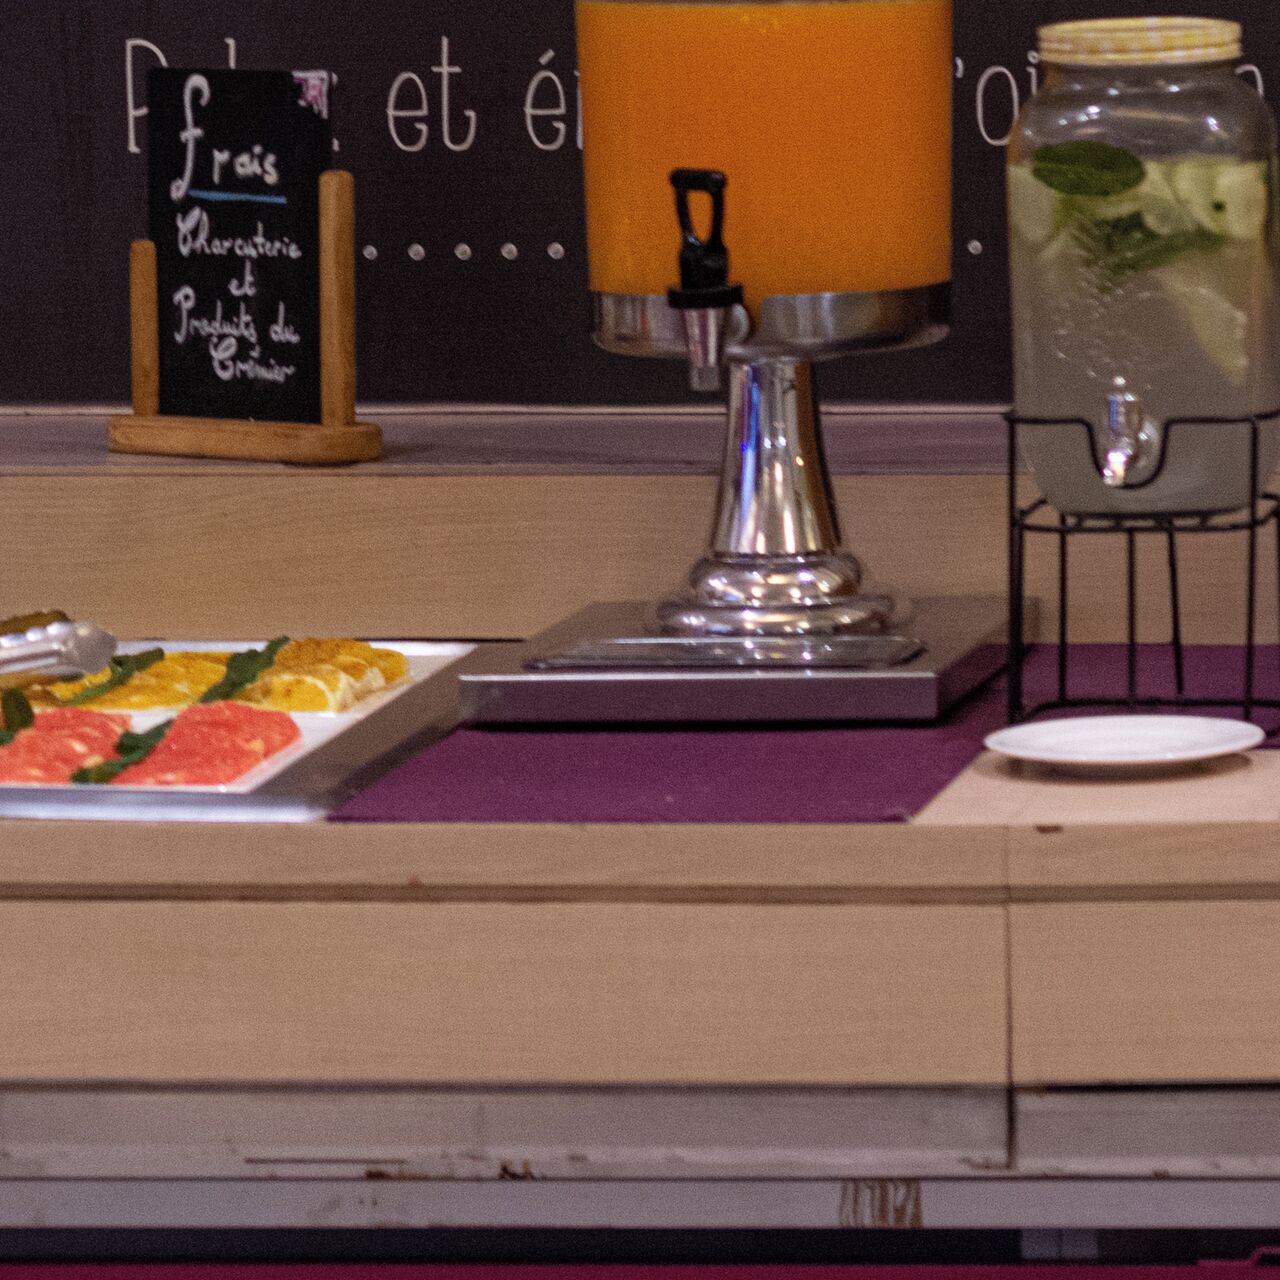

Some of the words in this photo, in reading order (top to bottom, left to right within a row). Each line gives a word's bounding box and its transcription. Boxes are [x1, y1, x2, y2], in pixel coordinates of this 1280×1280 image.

[387, 37, 476, 151] et
[175, 206, 303, 259] Charcuterie
[227, 259, 257, 297] et
[172, 285, 258, 344] Produits
[269, 301, 301, 344] du
